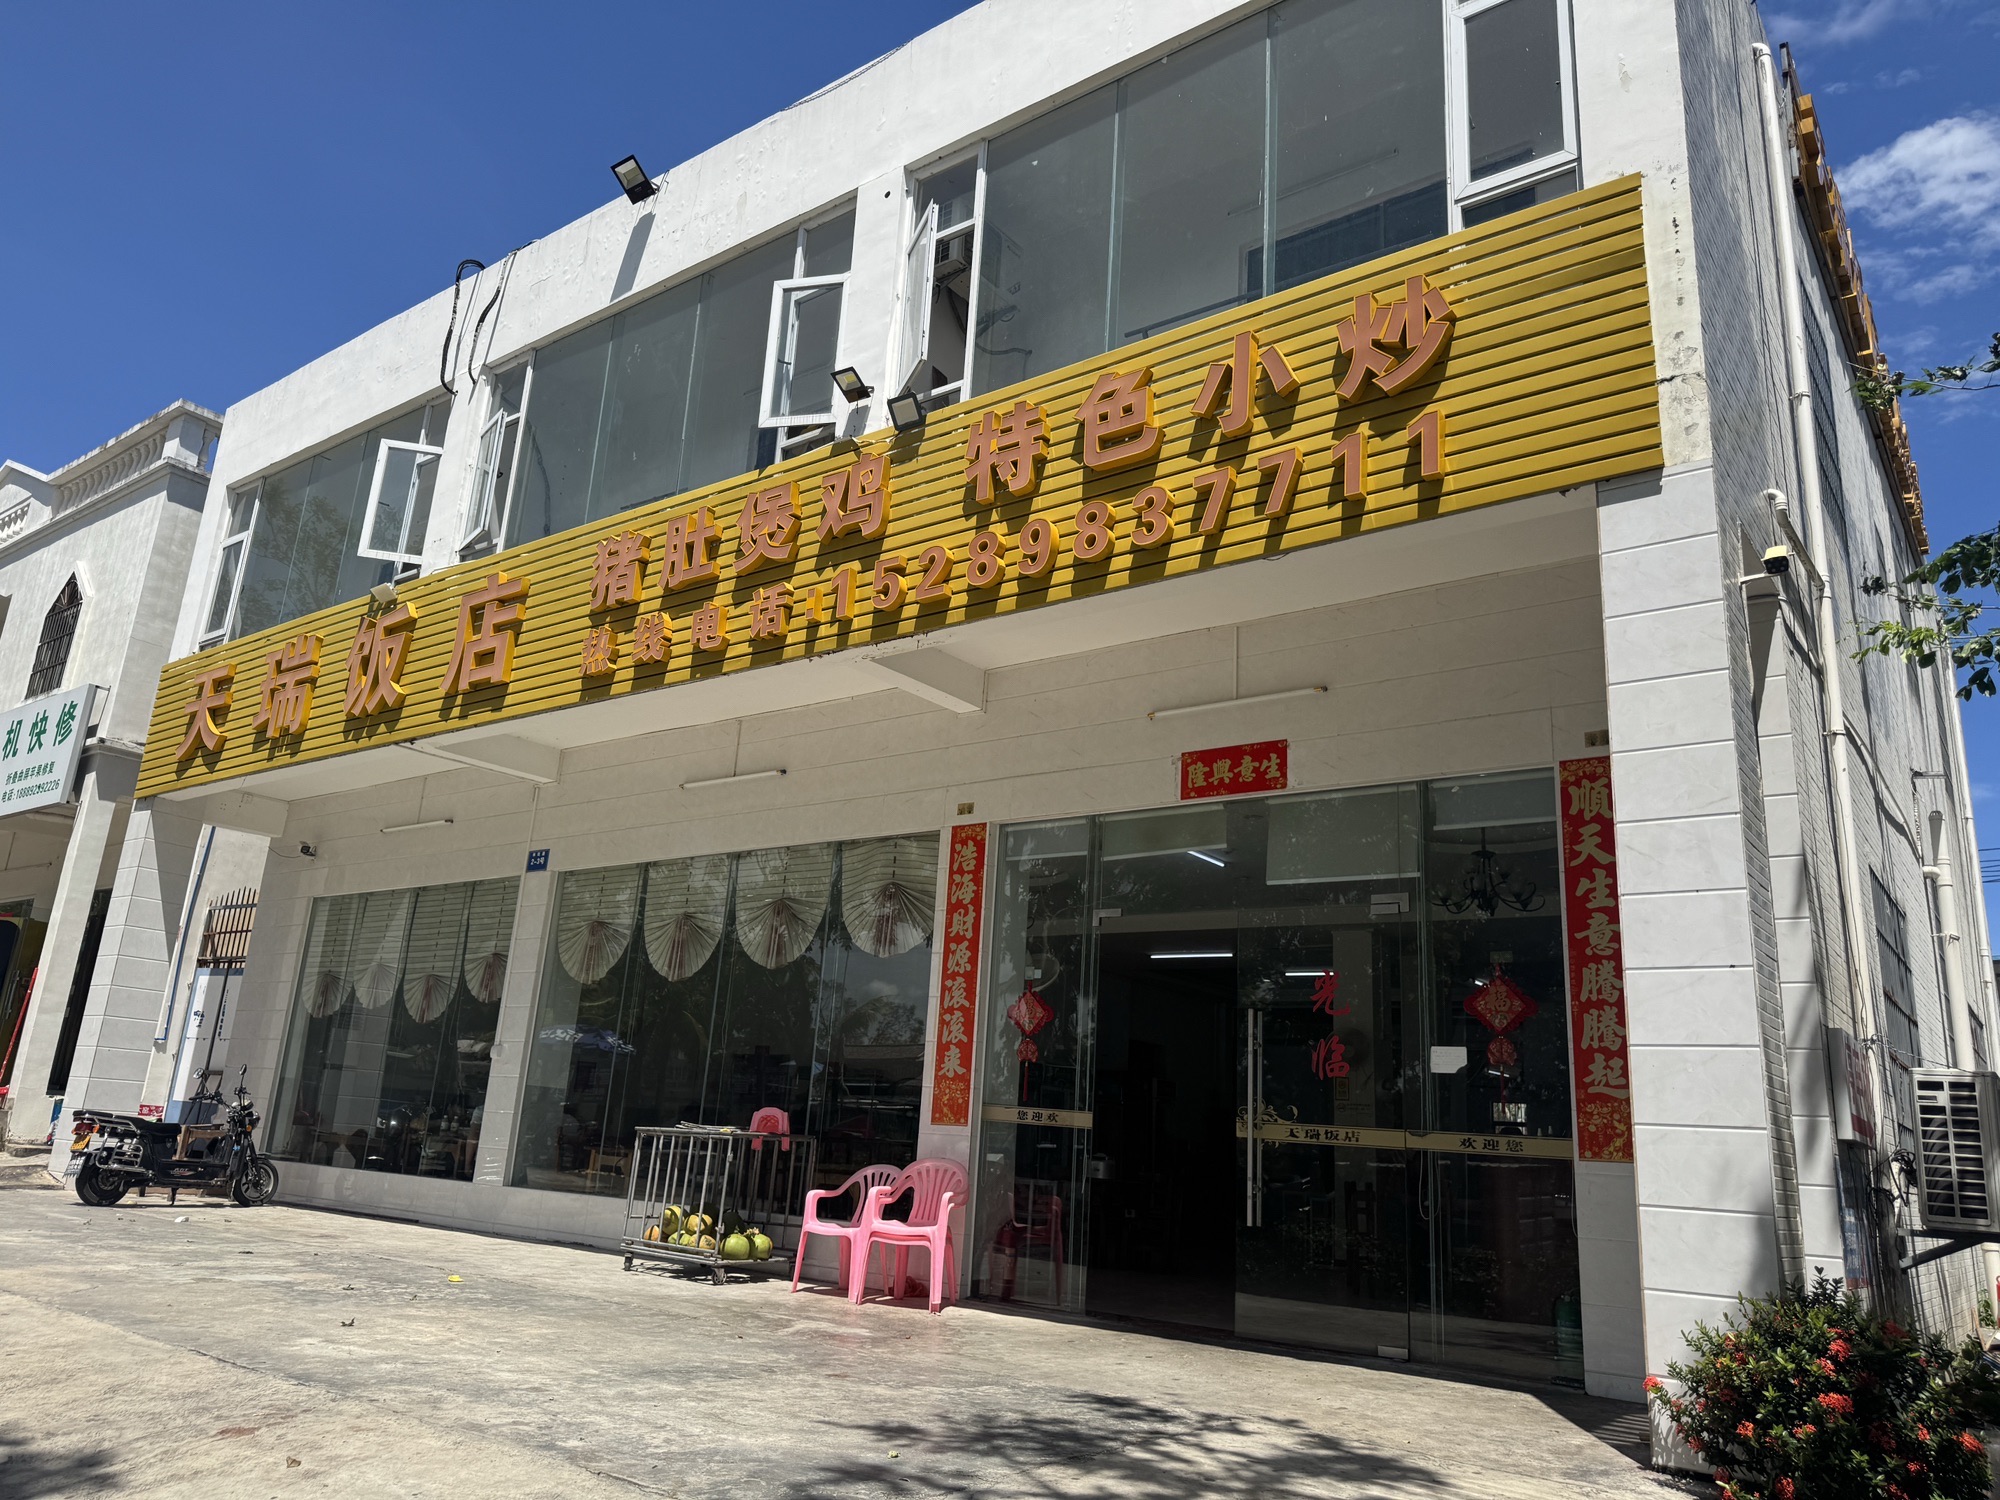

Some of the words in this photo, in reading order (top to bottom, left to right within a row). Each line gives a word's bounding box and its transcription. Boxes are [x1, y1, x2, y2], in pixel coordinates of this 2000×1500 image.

[589, 453, 892, 611] 猪肚煲鸡
[964, 274, 1457, 505] 特色小炒
[175, 571, 531, 761] 天瑞饭店
[2, 700, 79, 762] 机快修
[5, 761, 56, 786] 折叠曲屏苹果修复
[1284, 1126, 1362, 1143] 天瑞饭店
[1458, 1136, 1524, 1152] 欢迎您
